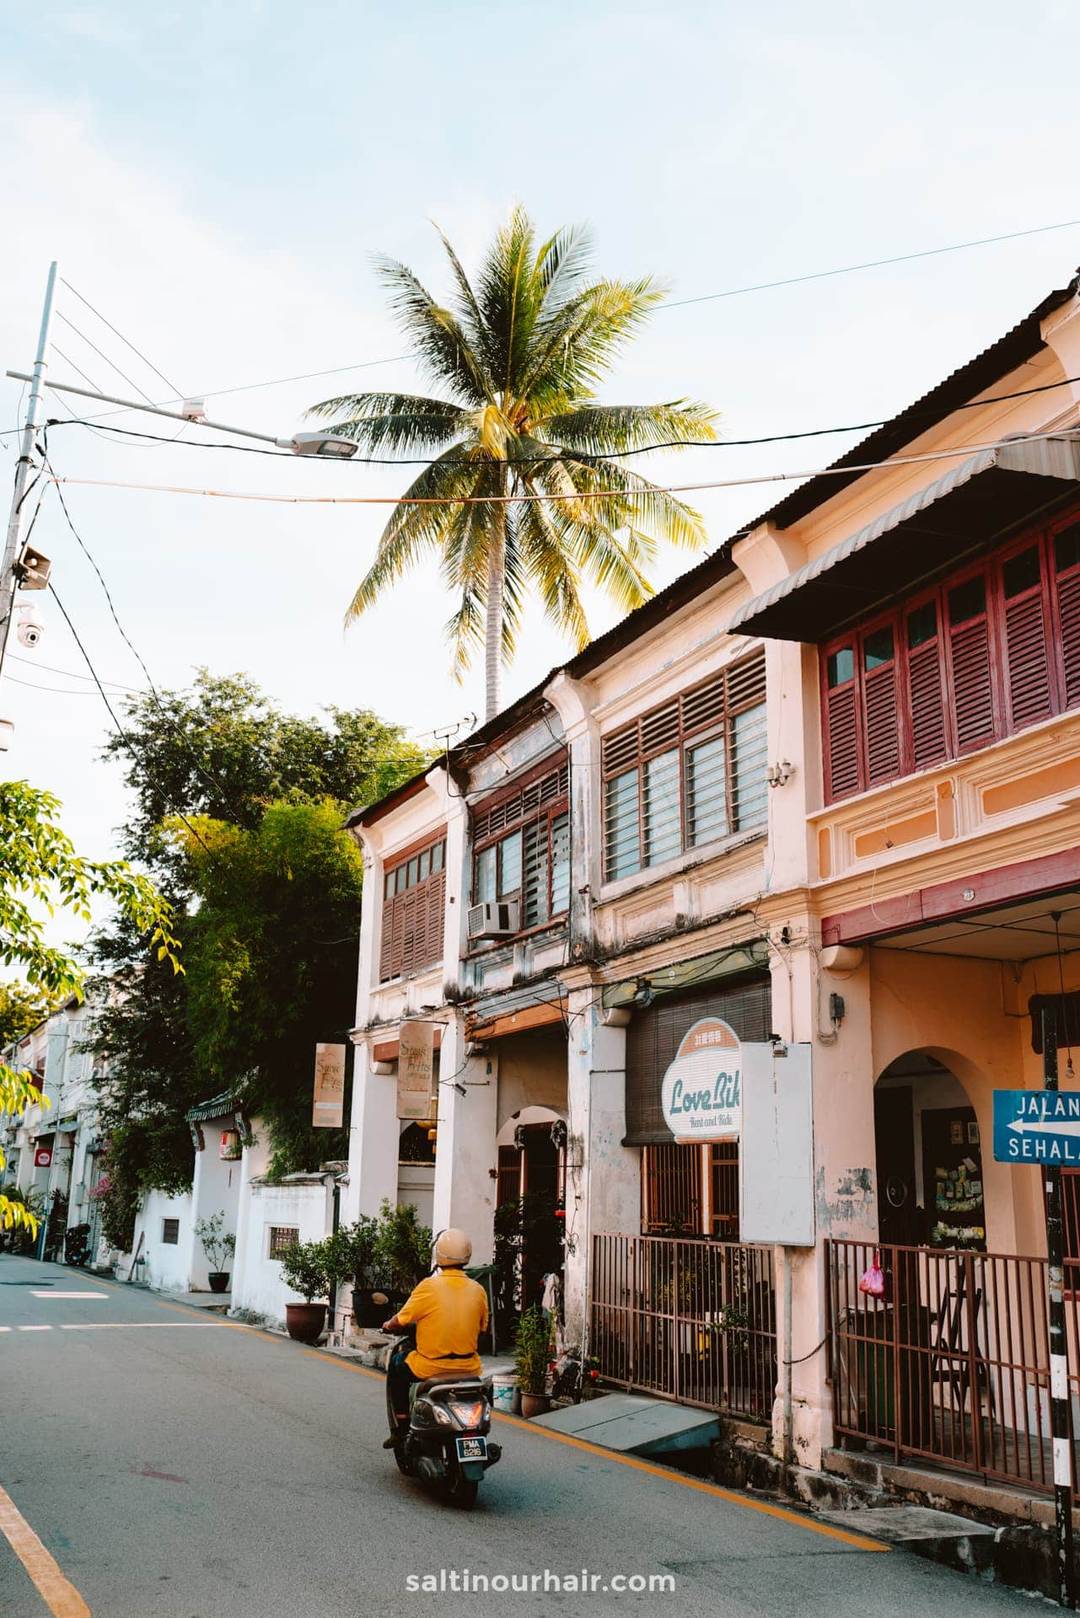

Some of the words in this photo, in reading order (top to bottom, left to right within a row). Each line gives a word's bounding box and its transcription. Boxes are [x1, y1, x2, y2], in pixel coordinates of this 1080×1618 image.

[1017, 1097, 1080, 1116] JALAN
[704, 1115, 717, 1126] and
[1009, 1138, 1080, 1159] SEHAL
